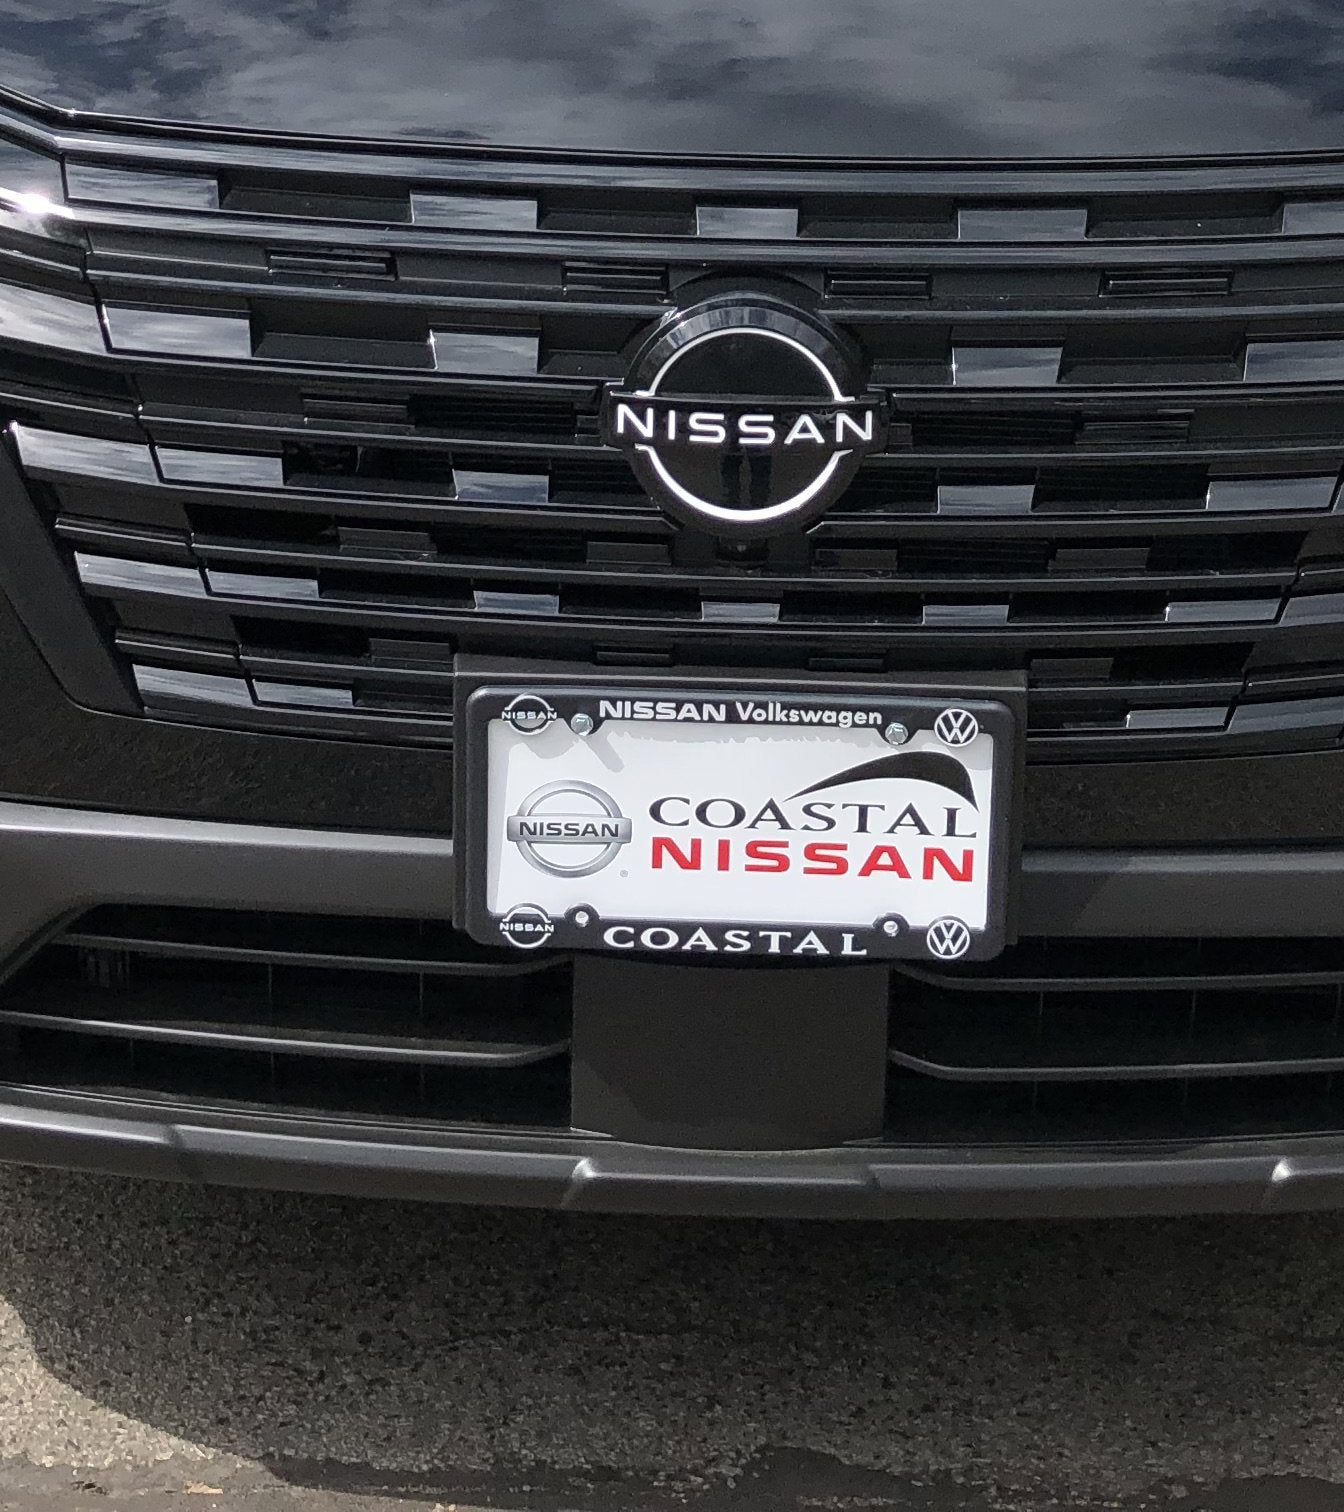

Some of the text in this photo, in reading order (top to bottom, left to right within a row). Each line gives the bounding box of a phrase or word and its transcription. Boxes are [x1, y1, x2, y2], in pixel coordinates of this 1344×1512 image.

[616, 403, 874, 445] NISSAN
[501, 711, 557, 720] NISSAN
[599, 700, 882, 729] NISSAN Volkswagen
[519, 820, 620, 839] NISSAN
[649, 796, 978, 839] COASTAL
[651, 836, 974, 883] NISSAN
[499, 922, 555, 933] NISSAN
[603, 926, 867, 956] COASTAL
